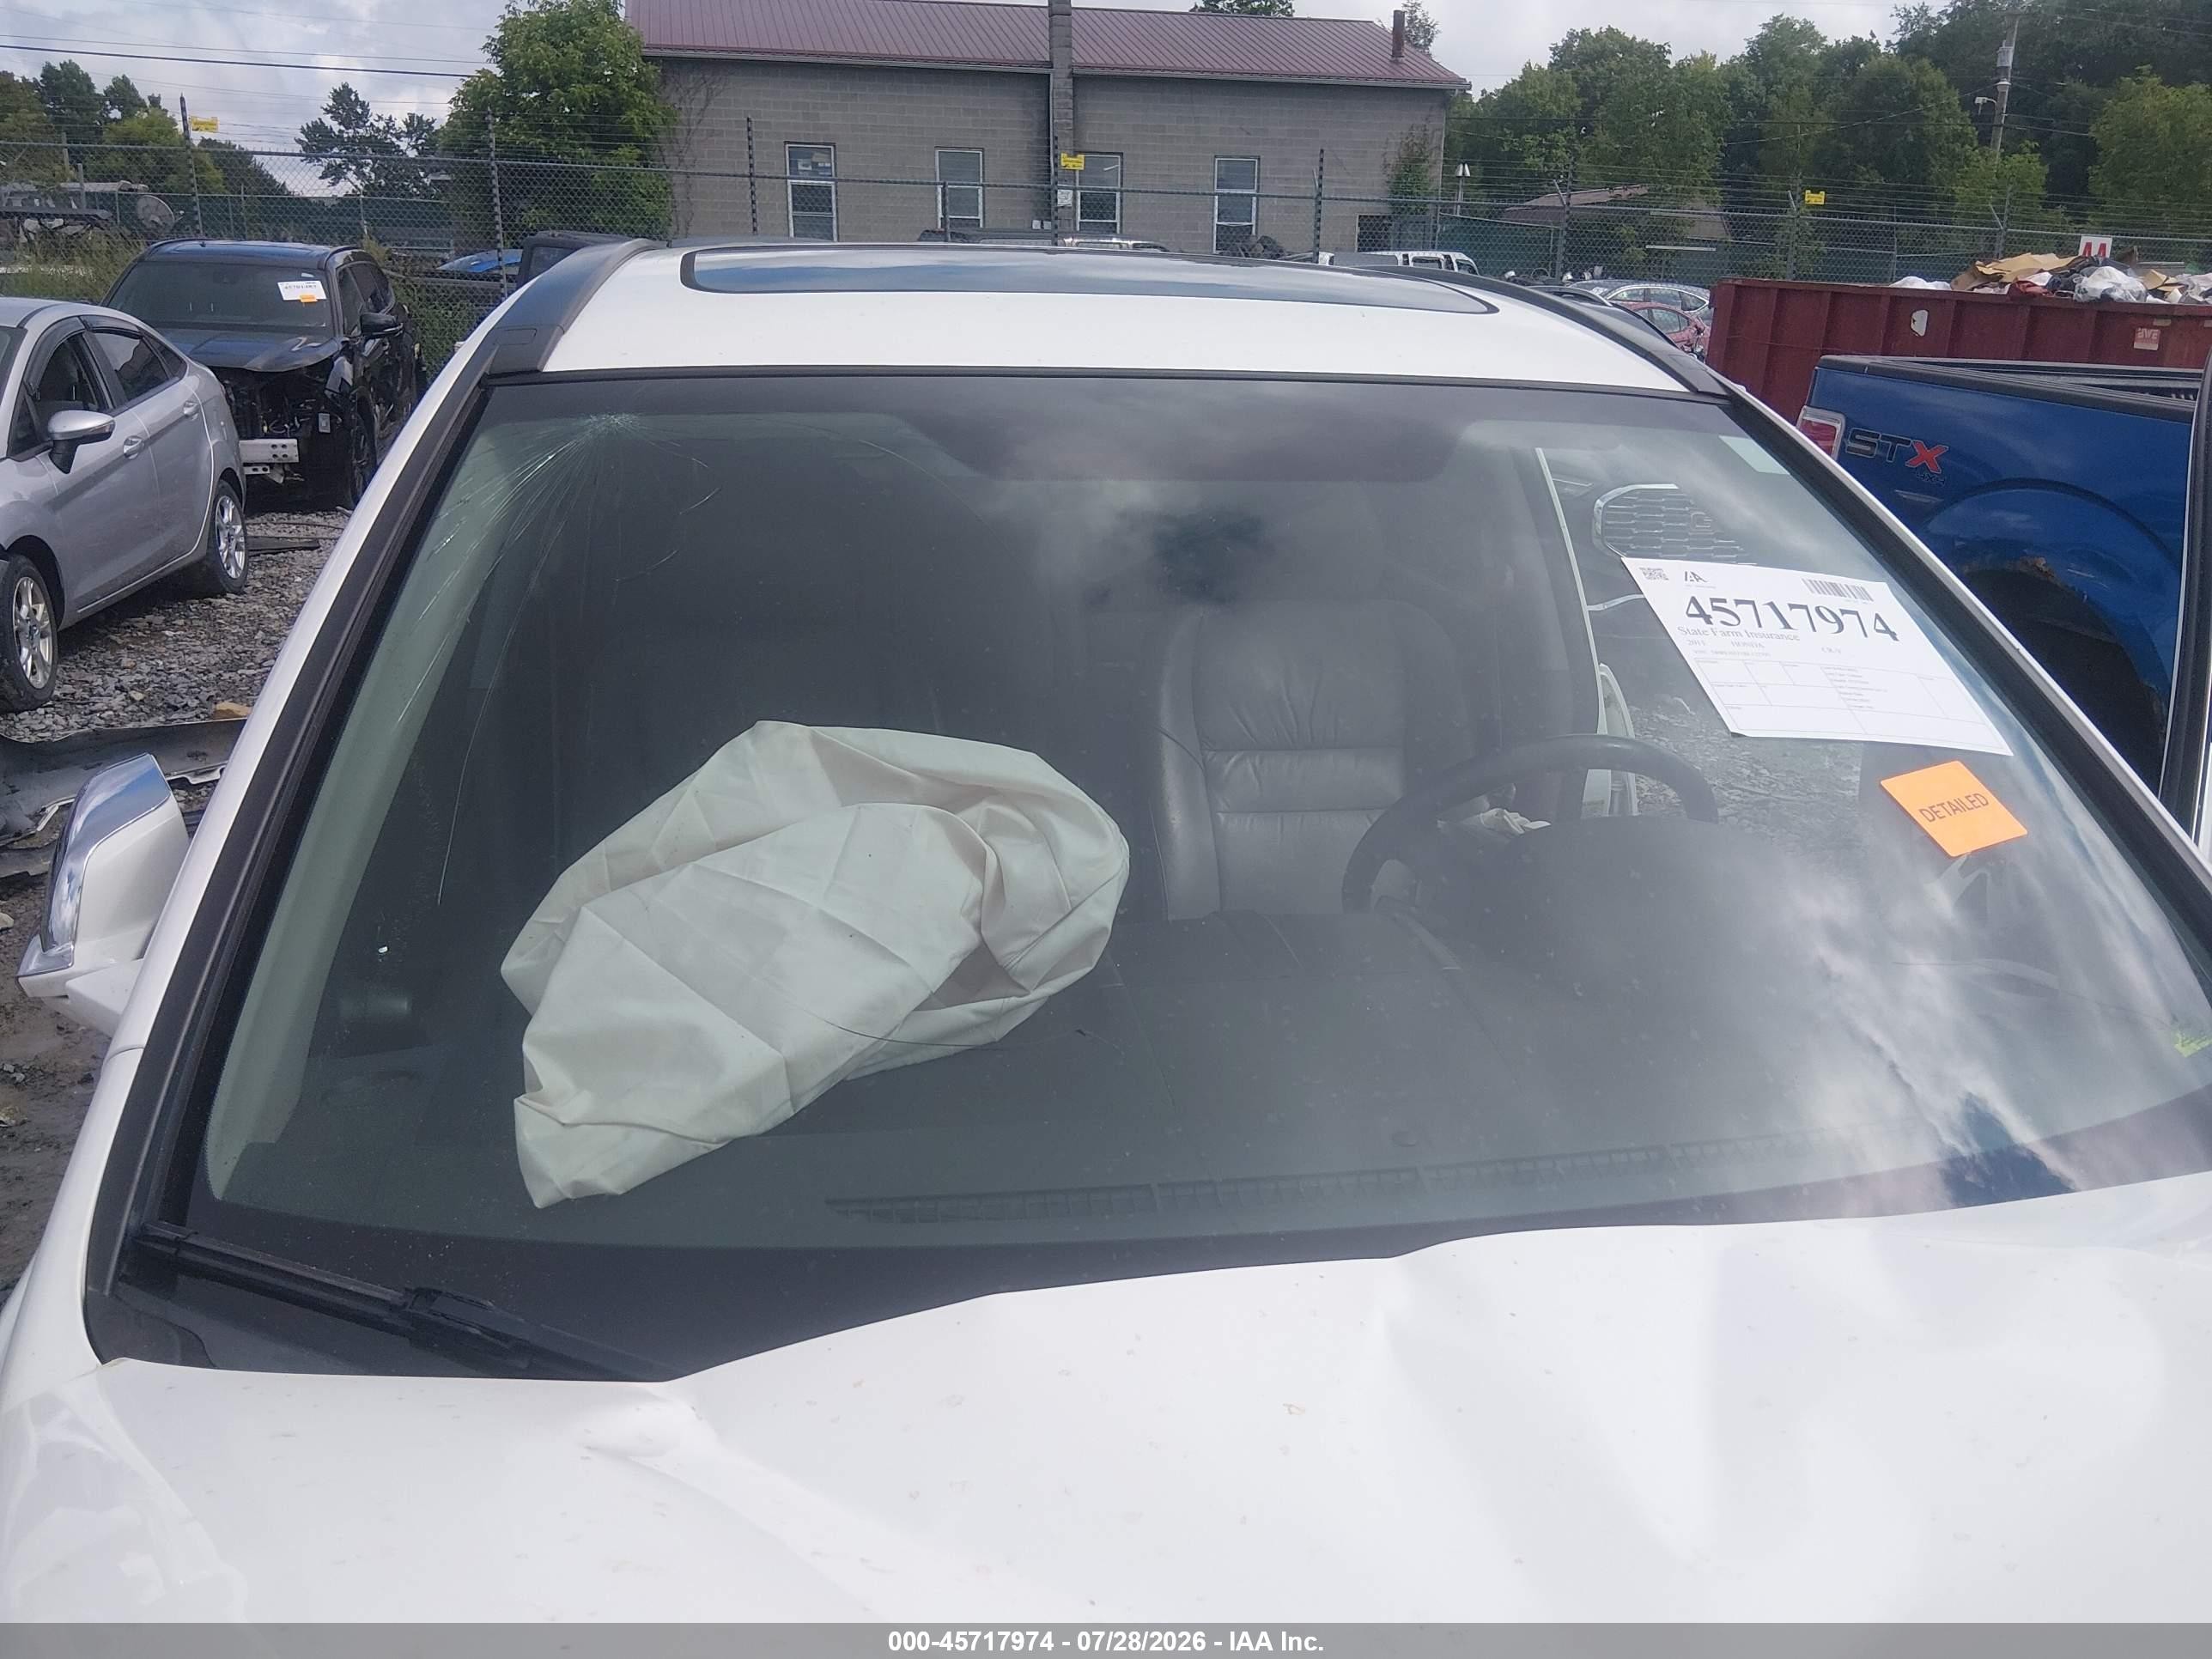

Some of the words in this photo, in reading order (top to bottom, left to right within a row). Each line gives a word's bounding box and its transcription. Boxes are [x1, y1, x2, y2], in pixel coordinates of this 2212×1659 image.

[1846, 428, 1949, 473] STX
[1677, 626, 1709, 636] State
[1711, 628, 1742, 638] Farm
[1744, 629, 1800, 641] Insurance
[1685, 595, 1899, 641] 45717974
[1919, 793, 1989, 823] DETAILED
